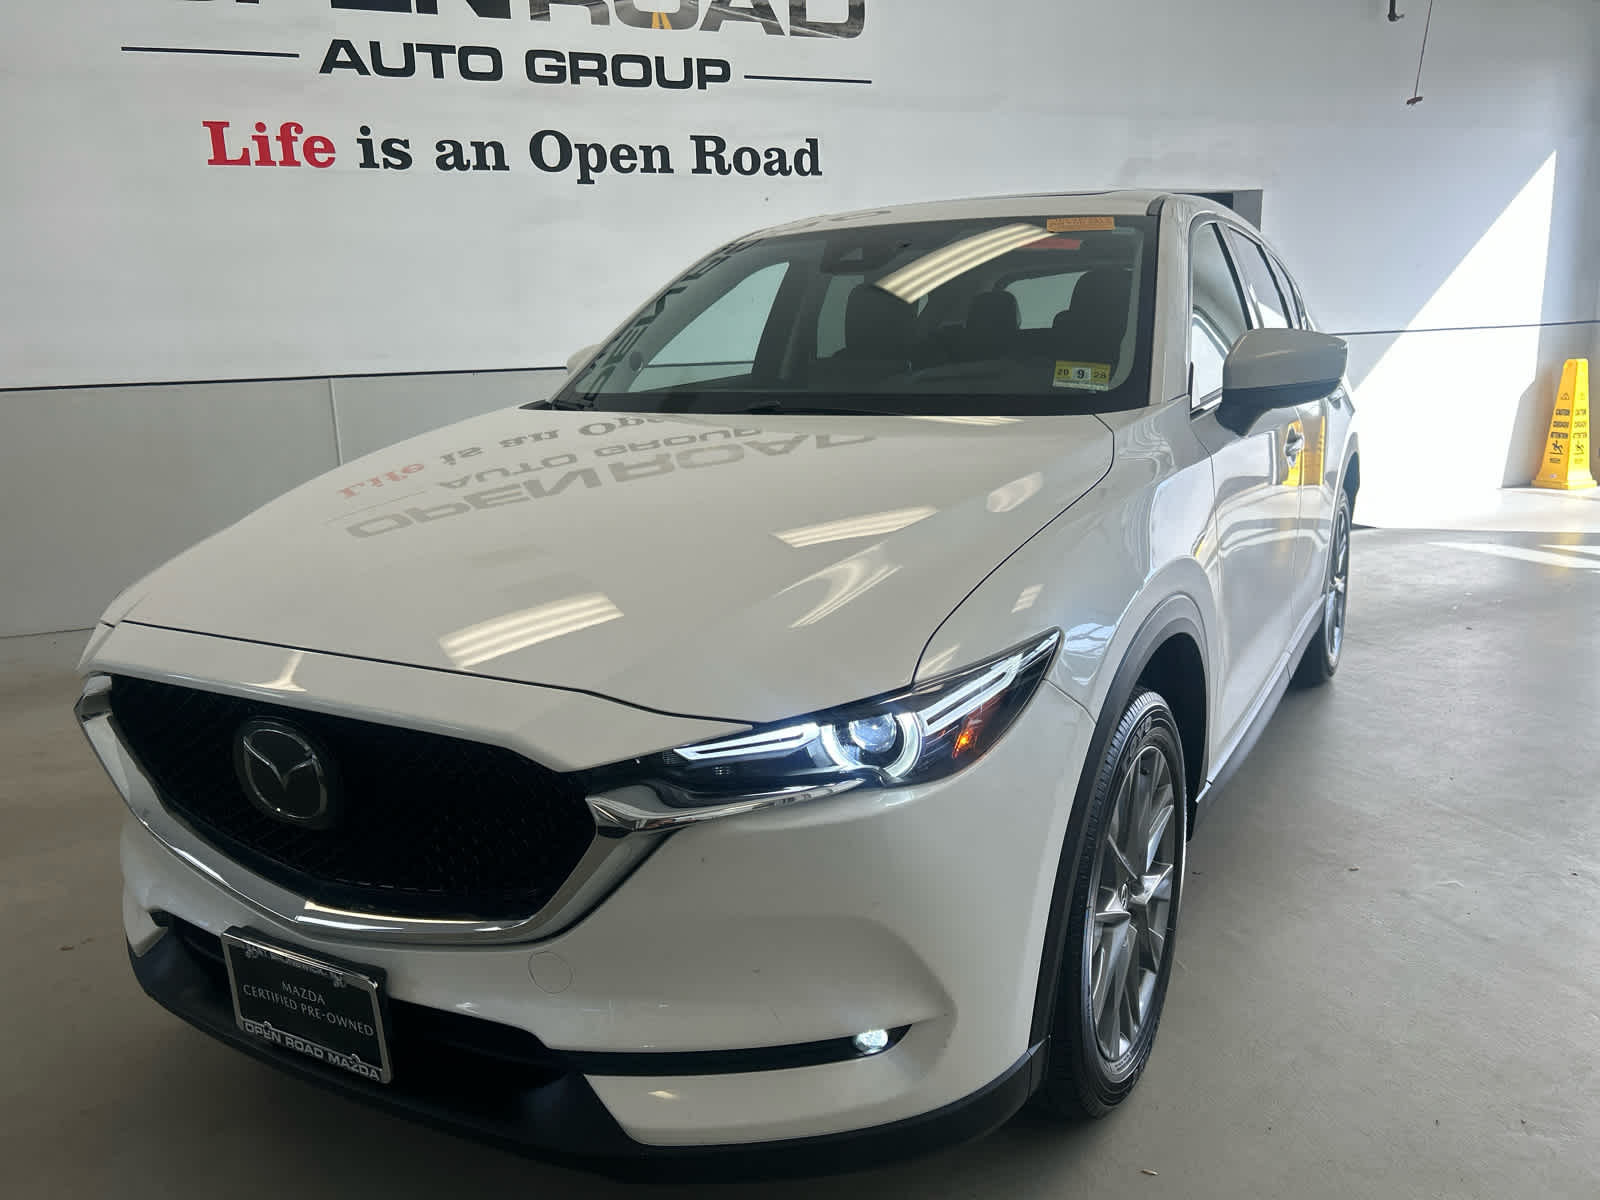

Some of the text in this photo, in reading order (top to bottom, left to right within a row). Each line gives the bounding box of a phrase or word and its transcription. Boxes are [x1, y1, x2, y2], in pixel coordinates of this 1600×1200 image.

[318, 39, 731, 90] AUTO GROUP
[202, 120, 823, 185] Life is an Open Road
[1077, 369, 1085, 379] 9
[243, 984, 374, 1037] CERTIFIED PRE-OWNED
[281, 980, 326, 1006] MAZDA
[244, 1023, 380, 1081] OPEN ROAD MAZDA
